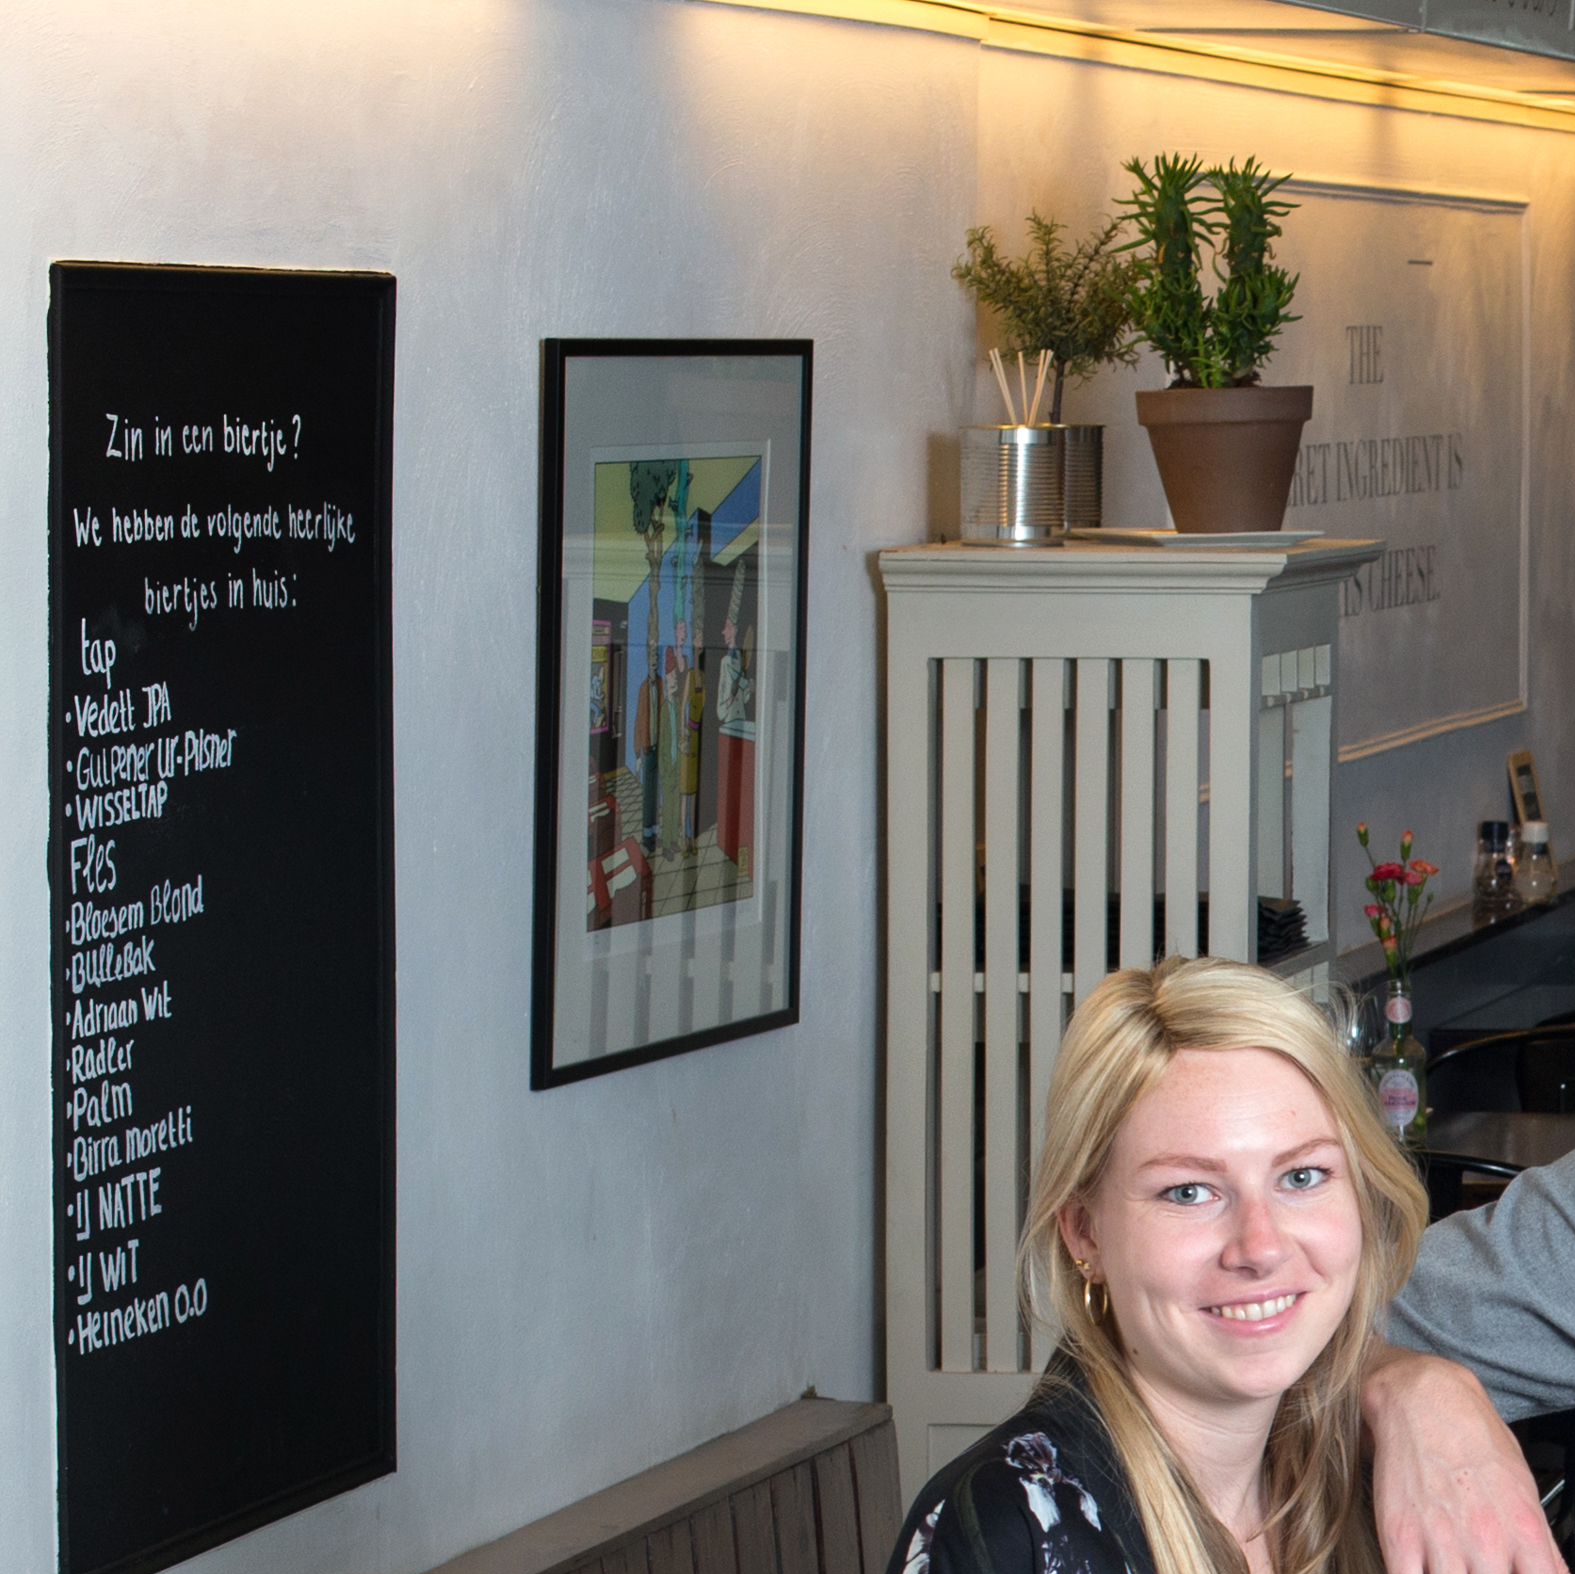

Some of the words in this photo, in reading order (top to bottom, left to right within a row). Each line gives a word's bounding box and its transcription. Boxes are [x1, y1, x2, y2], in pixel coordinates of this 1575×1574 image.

[1345, 325, 1384, 384] THE
[105, 413, 143, 462] Zin
[154, 415, 172, 457] in
[182, 424, 213, 453] een
[1288, 441, 1331, 508] RET
[1336, 433, 1443, 503] INGREDIENT
[1446, 431, 1464, 493] IS
[73, 506, 103, 547] We
[112, 507, 174, 544] hebben
[180, 504, 200, 538] de
[207, 504, 282, 554] volgende
[288, 501, 356, 553] heerlijke
[144, 577, 218, 631] biertjes
[228, 572, 244, 609] in
[252, 567, 297, 609] huis:
[82, 617, 117, 689] tap
[74, 688, 136, 738] Vedett
[76, 742, 155, 791] Gulpener
[75, 780, 168, 832] WISSELTAP
[70, 833, 117, 895] Fles
[71, 900, 144, 945] Bloesem
[150, 874, 204, 926] Blond
[71, 998, 138, 1041] Adriaan
[141, 979, 172, 1021] Wit
[71, 1036, 135, 1085] Radler
[73, 1079, 133, 1132] Palm
[73, 1135, 123, 1183] Birra
[98, 1167, 162, 1231] NATTE
[77, 1290, 171, 1356] Heineken
[174, 1277, 208, 1324] 0.0
